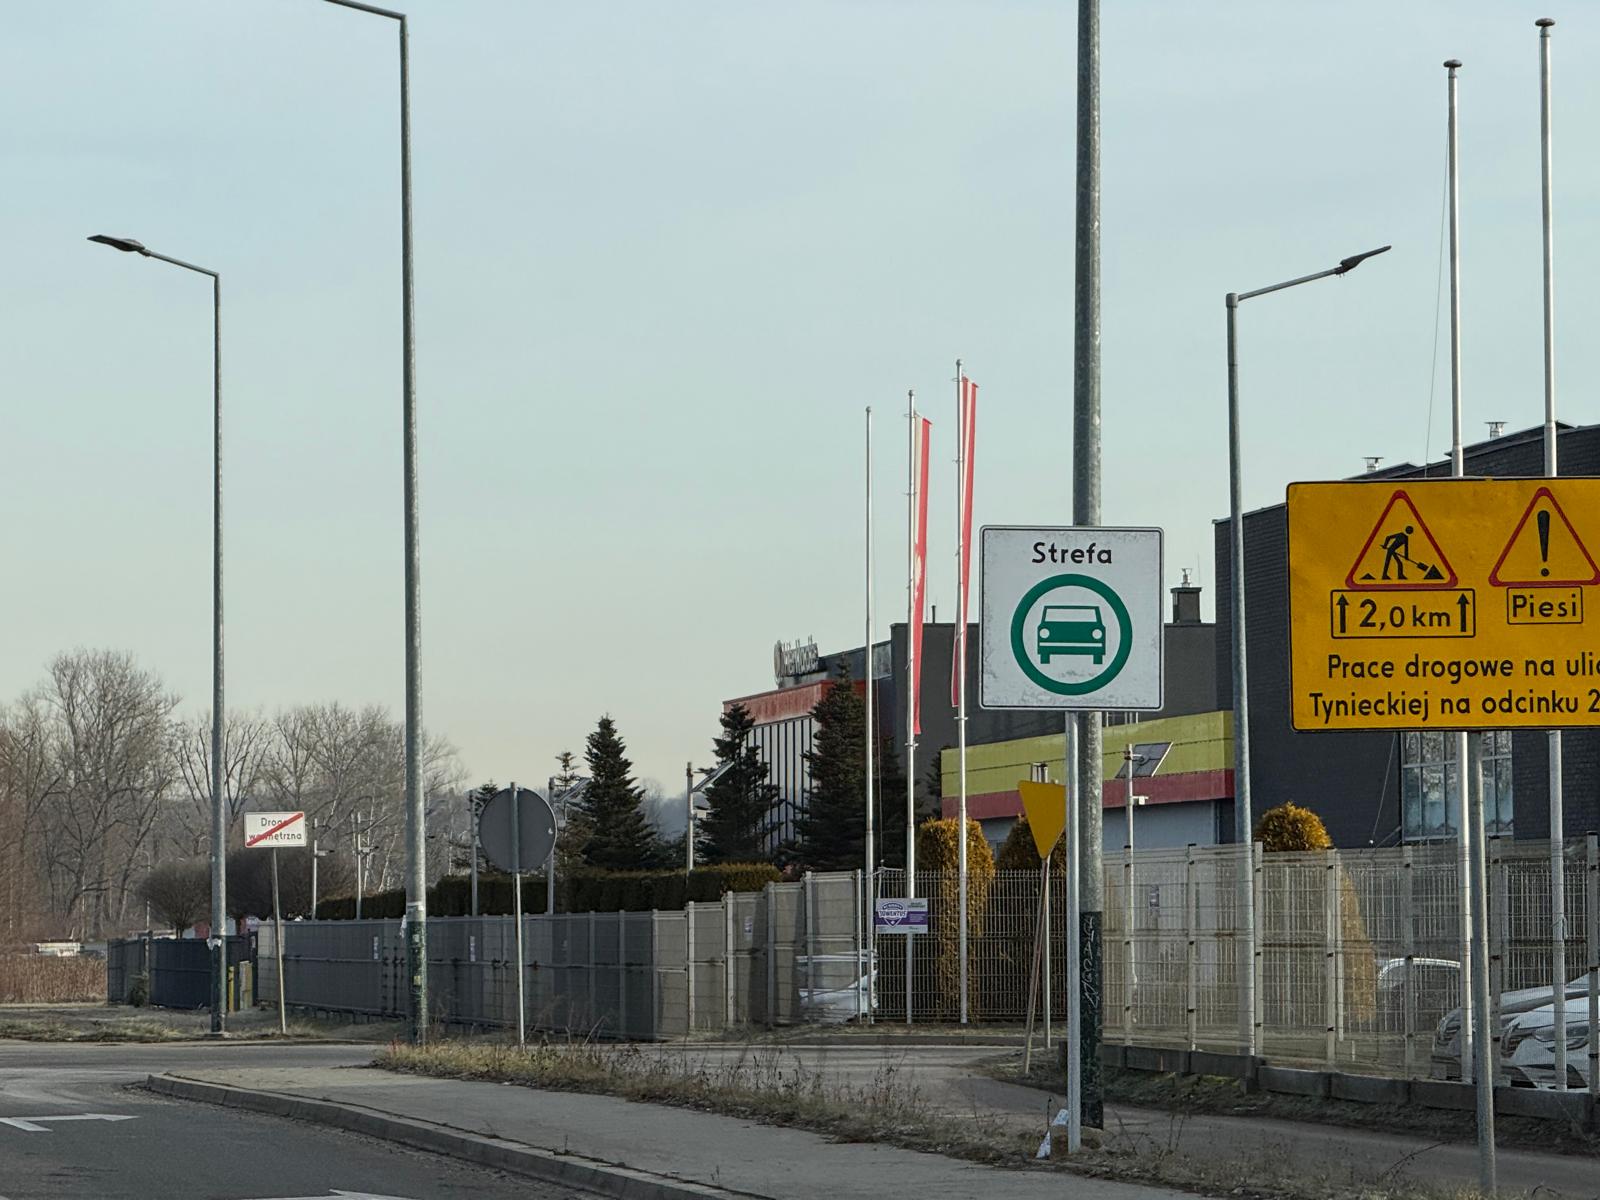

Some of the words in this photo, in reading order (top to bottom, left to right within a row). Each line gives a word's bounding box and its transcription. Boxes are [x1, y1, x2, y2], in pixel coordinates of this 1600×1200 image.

[1031, 542, 1112, 564] Strefa
[1359, 599, 1405, 631] 2,0
[1412, 605, 1451, 627] km
[1511, 593, 1577, 618] Piesi
[1328, 654, 1394, 678] Prace
[1405, 653, 1513, 684] drogowe
[1525, 658, 1555, 676] na
[1309, 691, 1429, 724] Tynieckiej
[1441, 697, 1470, 714] na
[1482, 690, 1578, 713] odcinku
